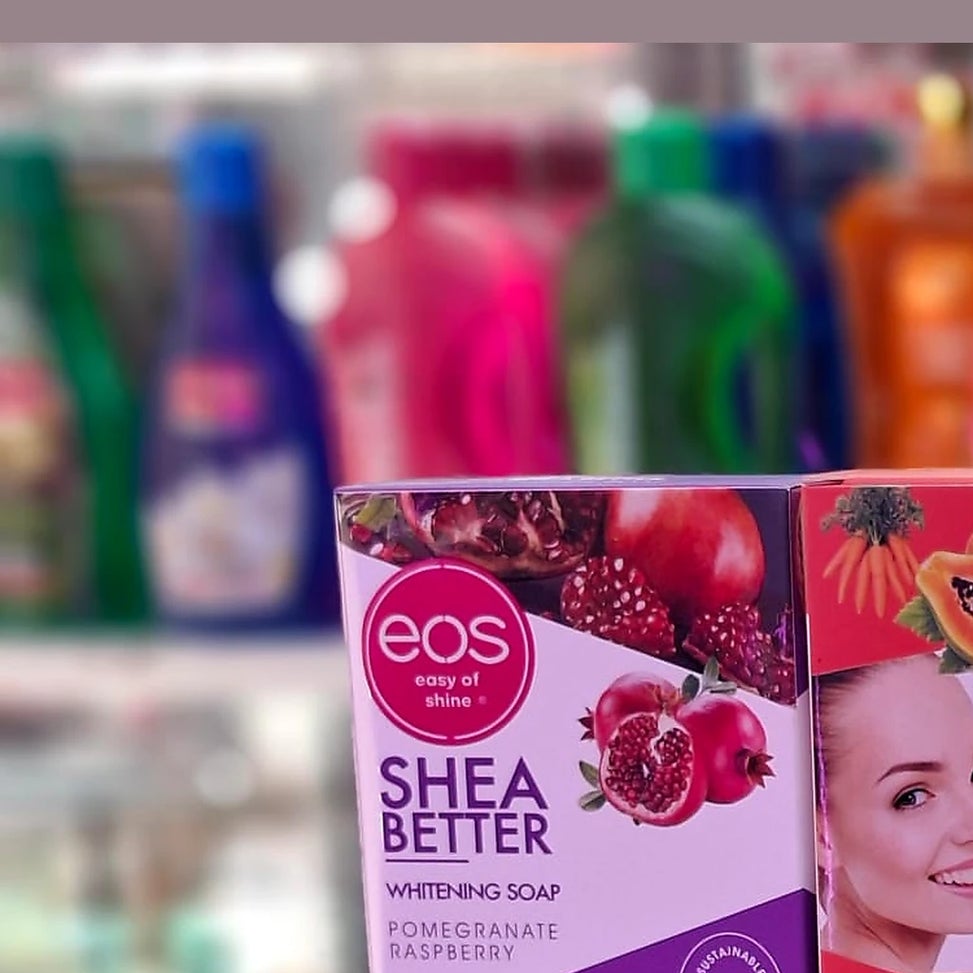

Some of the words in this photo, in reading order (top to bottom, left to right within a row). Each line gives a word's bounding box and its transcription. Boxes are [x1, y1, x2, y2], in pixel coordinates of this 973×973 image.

[379, 614, 510, 665] eos
[415, 673, 457, 690] easy
[462, 672, 480, 687] of
[380, 755, 549, 810] SHEA
[383, 812, 552, 856] BETTER
[386, 882, 501, 902] WHITENING
[507, 883, 561, 902] SOAP
[388, 921, 559, 940] POMEGRANATE
[389, 942, 515, 961] RASPBERRY
